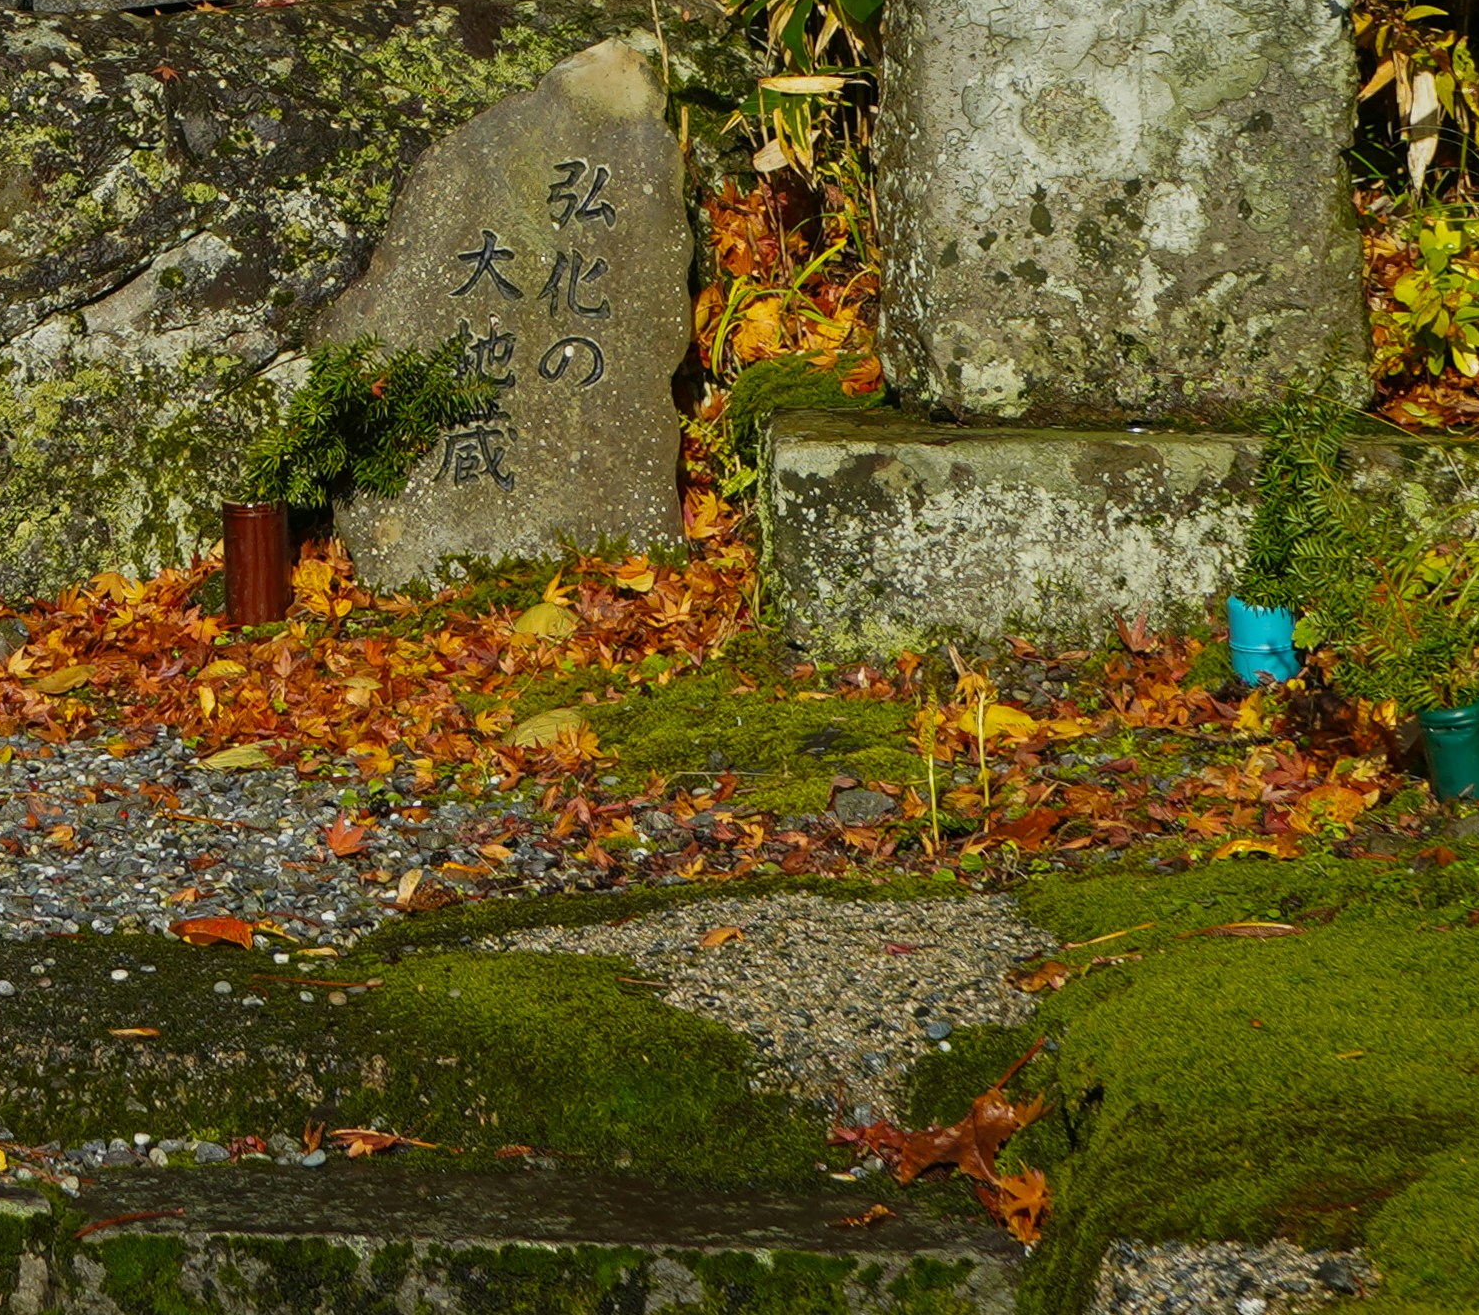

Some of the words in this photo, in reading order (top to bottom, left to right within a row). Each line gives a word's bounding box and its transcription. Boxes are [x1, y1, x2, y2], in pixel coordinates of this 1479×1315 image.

[434, 230, 524, 493] 大地蔵
[538, 159, 617, 388] 弘化の
